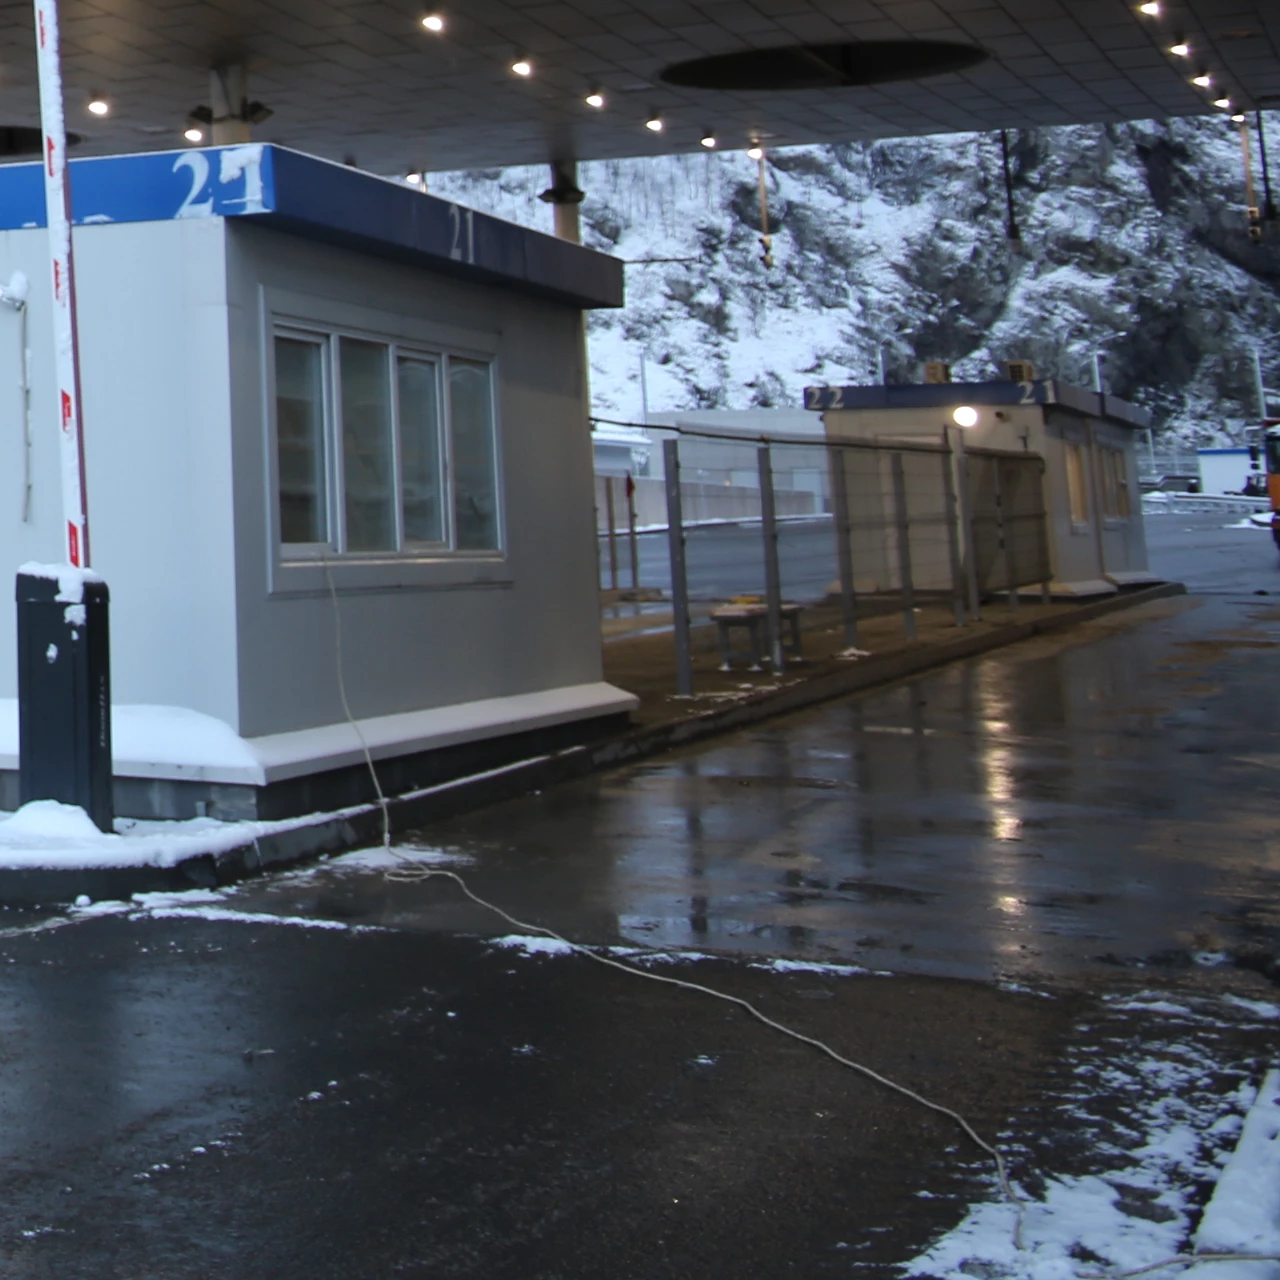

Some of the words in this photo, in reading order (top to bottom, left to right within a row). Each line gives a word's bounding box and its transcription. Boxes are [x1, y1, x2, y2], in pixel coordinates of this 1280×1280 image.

[448, 204, 476, 265] 21
[807, 386, 845, 409] 22
[1017, 380, 1057, 404] 21
